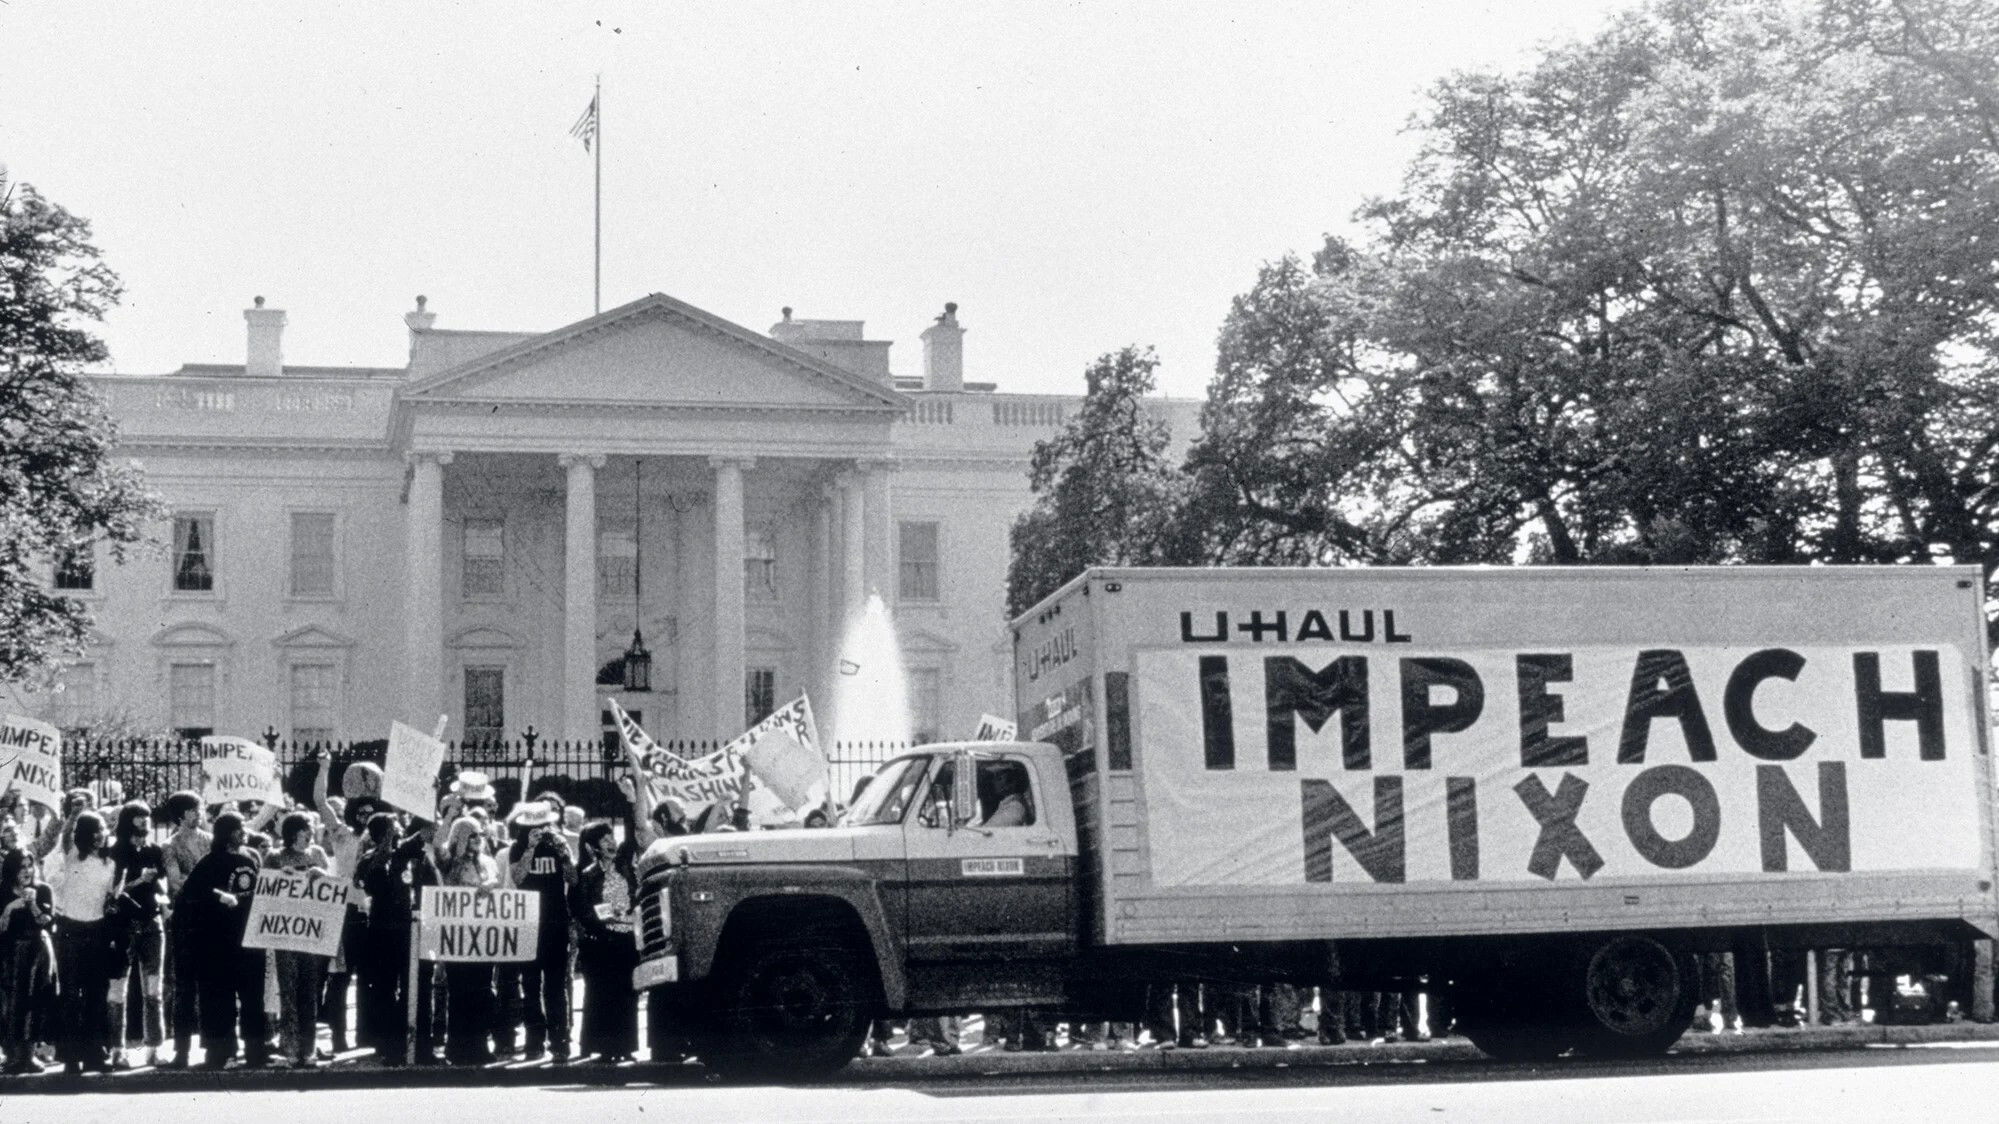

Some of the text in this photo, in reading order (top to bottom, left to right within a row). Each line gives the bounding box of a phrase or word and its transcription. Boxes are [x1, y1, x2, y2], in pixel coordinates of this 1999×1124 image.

[1181, 610, 1411, 642] U-HAUL
[1198, 648, 1946, 771] IMPEACH
[1301, 761, 1852, 884] NIXON
[256, 876, 348, 904] IMPEACH
[434, 891, 526, 920] IMPEACH
[260, 915, 322, 938] NIXON
[440, 925, 518, 957] NIXON
